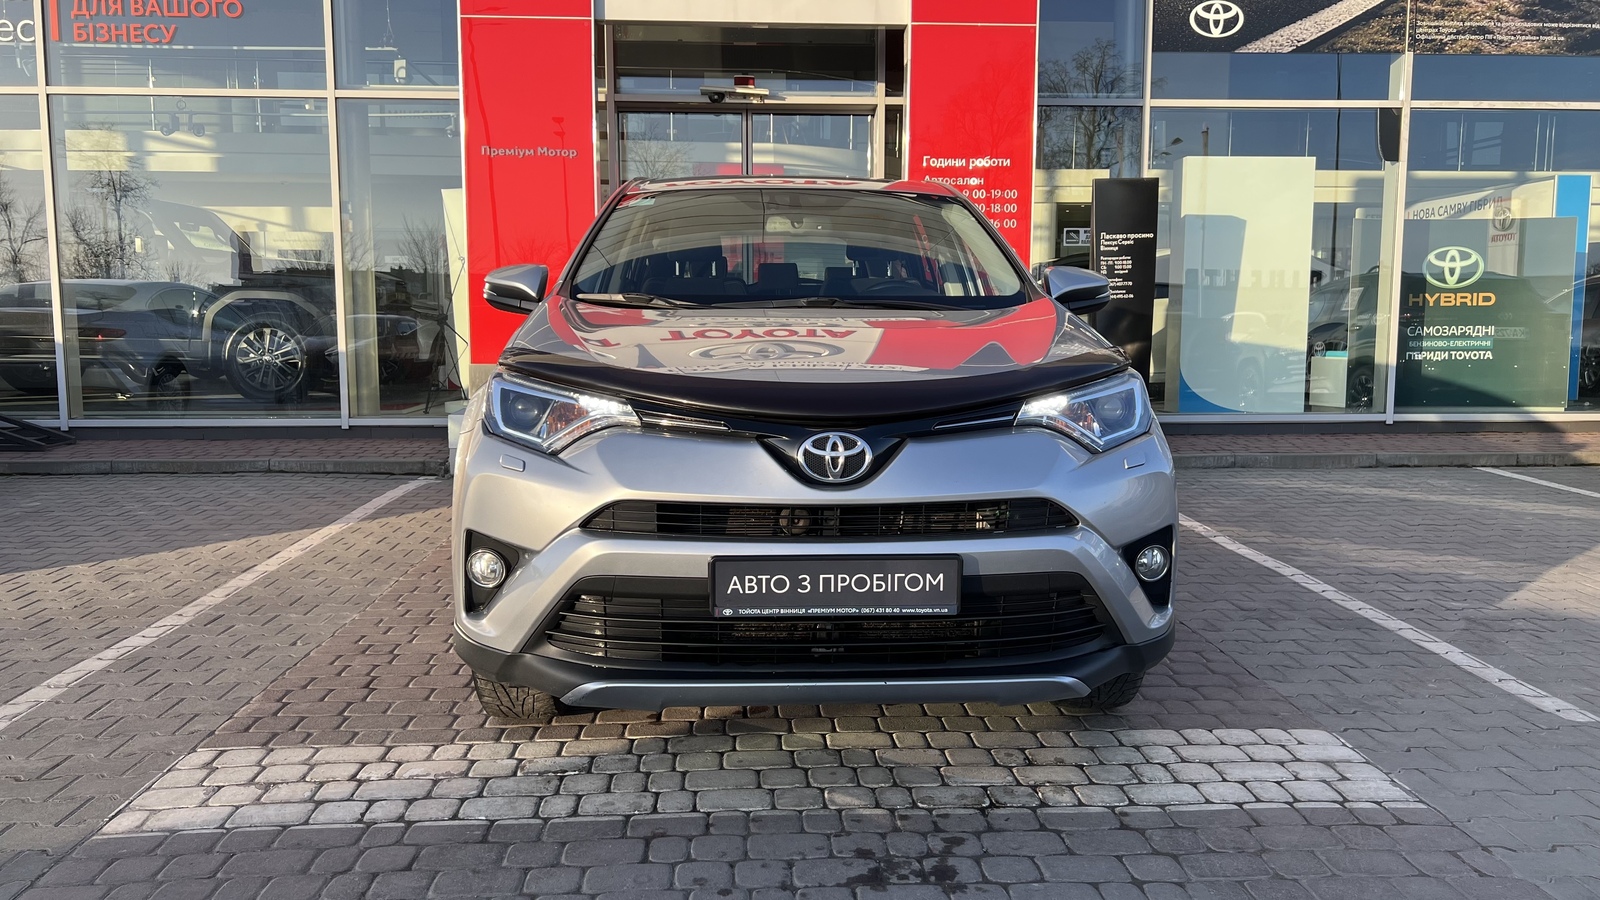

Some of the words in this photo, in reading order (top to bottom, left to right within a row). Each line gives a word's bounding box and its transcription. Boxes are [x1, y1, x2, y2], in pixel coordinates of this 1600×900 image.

[71, 0, 123, 18] ДЛЯ
[131, 0, 243, 17] ВАШОГО
[73, 22, 177, 43] БІЗНЕСУ
[481, 145, 534, 158] Преміум
[538, 146, 577, 159] Мотор
[922, 156, 966, 168] Години
[969, 156, 1011, 169] роботи
[1413, 207, 1435, 220] НОВА
[1437, 202, 1467, 217] CAMRY
[1127, 232, 1154, 240] просимо
[1408, 292, 1496, 307] HYBRID
[1407, 325, 1495, 337] САМОЗАРЯДНІ
[1406, 350, 1449, 361] ГІБРИДИ
[1450, 350, 1493, 360] TOYOTA
[726, 575, 790, 594] АВТО
[797, 574, 811, 593] З
[819, 573, 944, 593] ПРОБІГОМ
[738, 607, 761, 615] ТОЙОТА
